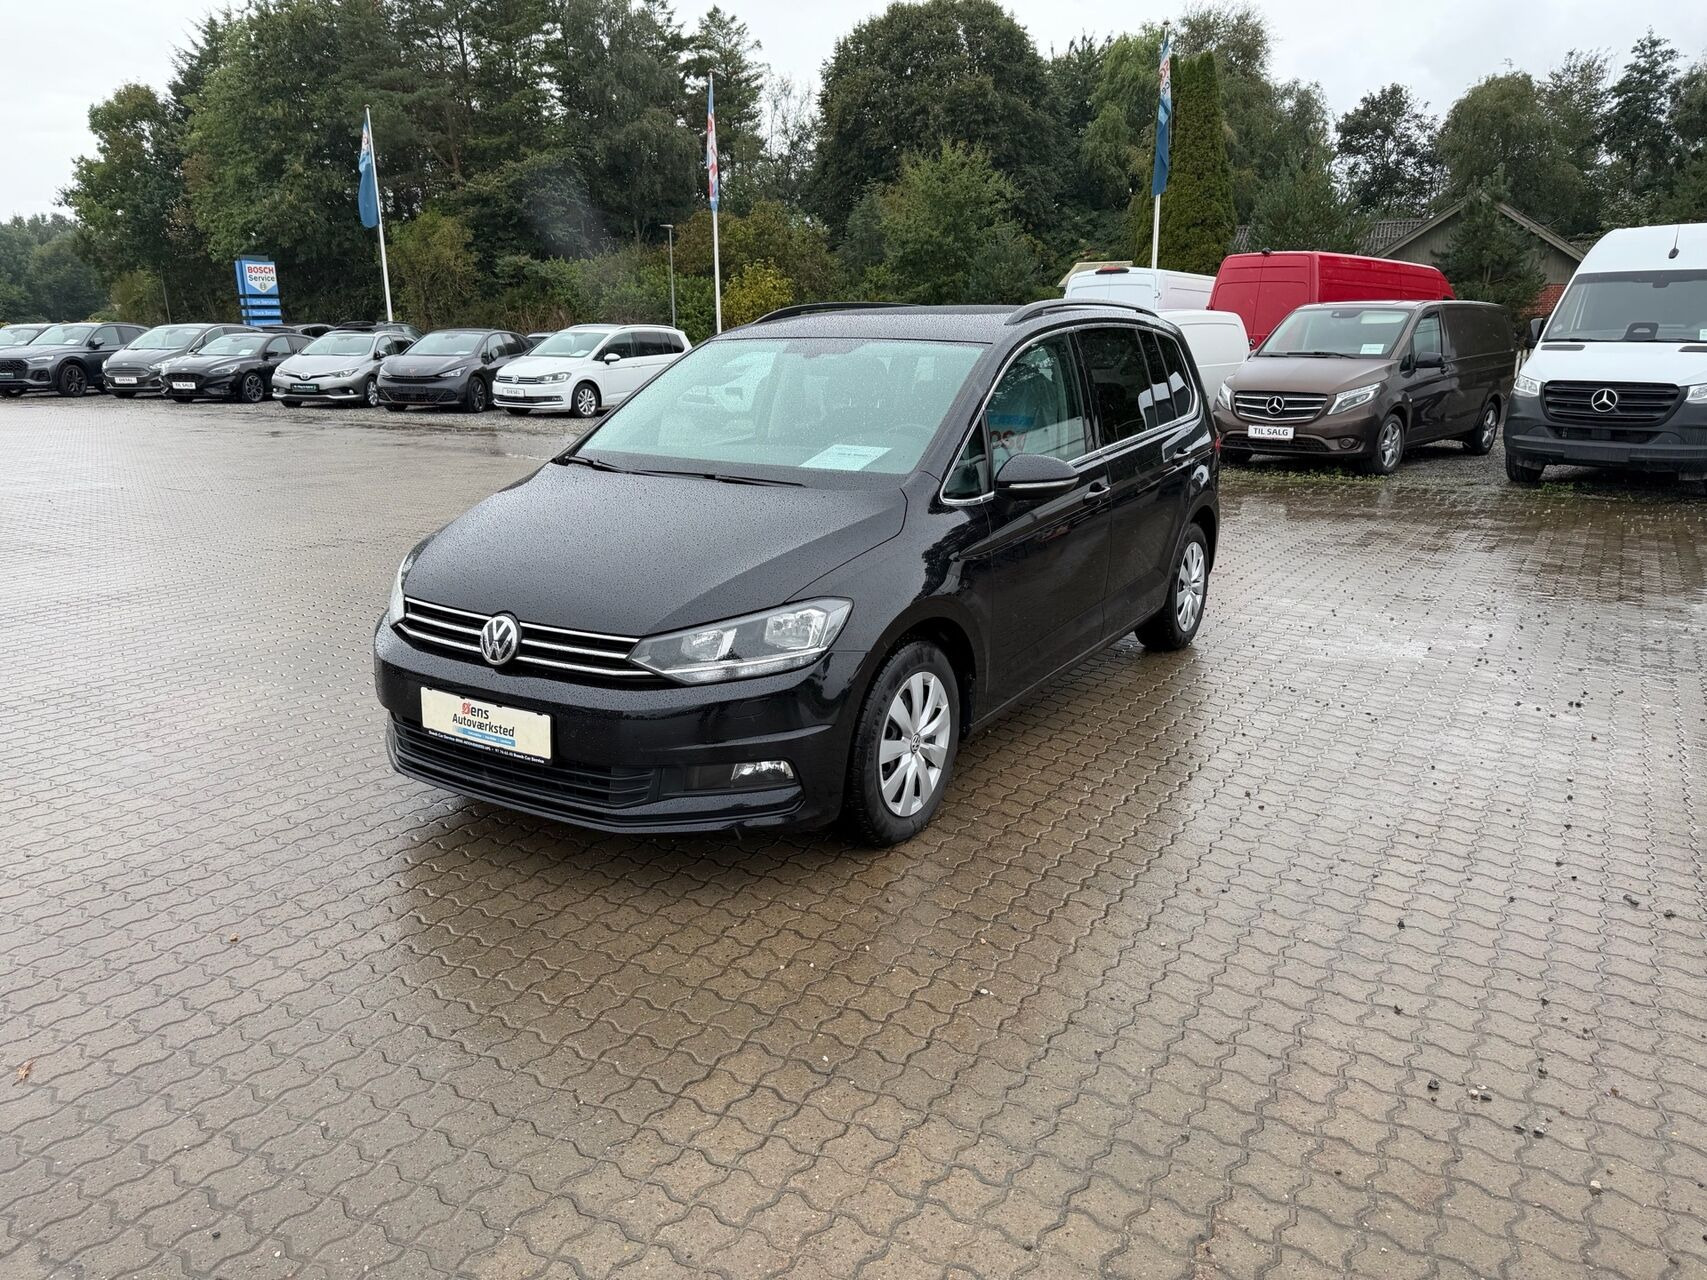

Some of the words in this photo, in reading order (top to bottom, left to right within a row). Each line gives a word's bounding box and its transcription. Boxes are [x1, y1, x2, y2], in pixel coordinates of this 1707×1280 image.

[247, 266, 275, 274] BOSCH
[248, 274, 275, 282] Service
[1253, 427, 1265, 435] TIL
[1267, 428, 1289, 436] SALG
[452, 713, 515, 738] Autoværksted
